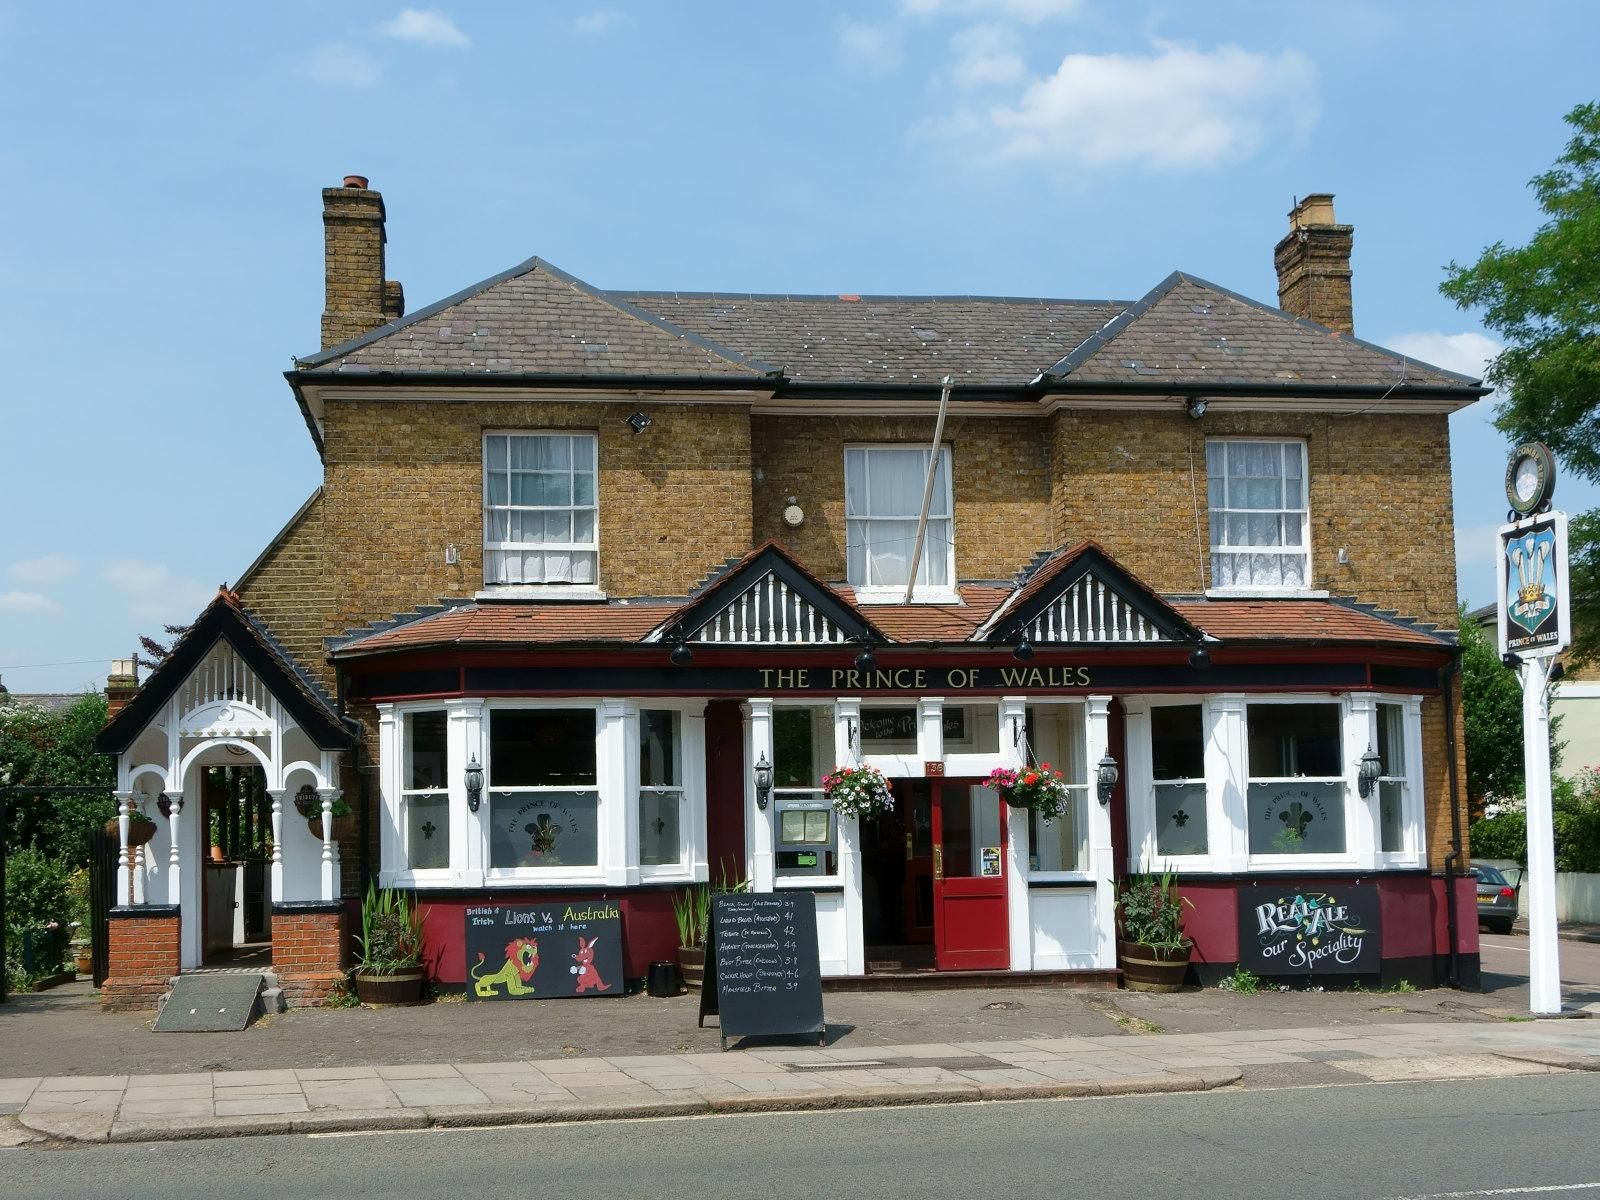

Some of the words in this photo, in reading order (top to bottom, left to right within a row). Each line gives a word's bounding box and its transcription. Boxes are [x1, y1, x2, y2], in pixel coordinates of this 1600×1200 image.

[1516, 446, 1540, 461] COMBE
[1508, 636, 1530, 648] PRINCE
[1535, 631, 1558, 643] WALES
[759, 669, 810, 688] THE
[831, 669, 927, 689] PRINCE
[947, 669, 980, 688] OF
[1000, 666, 1091, 687] WALES
[926, 763, 944, 772] 136
[518, 800, 546, 816] PRINCE
[549, 801, 560, 809] OF
[466, 907, 493, 916] British
[504, 909, 536, 925] Lions
[563, 905, 620, 922] Australia
[1255, 902, 1313, 936] REAL
[1306, 905, 1349, 936] ALE
[472, 917, 494, 926] Irish
[570, 923, 587, 931] here
[1262, 939, 1288, 958] our
[1288, 932, 1363, 969] Speciality
[752, 982, 777, 993] BITTER
